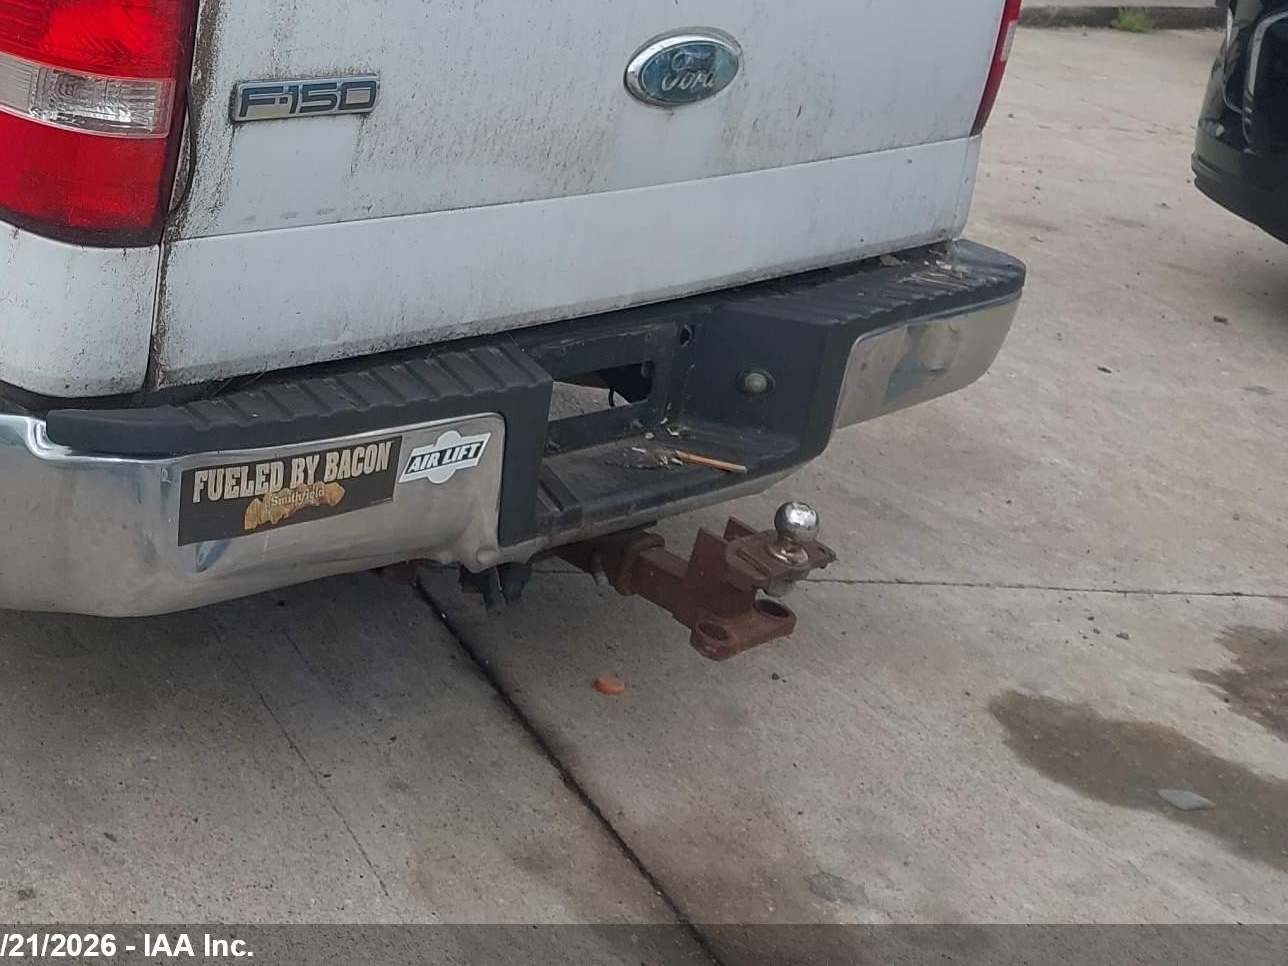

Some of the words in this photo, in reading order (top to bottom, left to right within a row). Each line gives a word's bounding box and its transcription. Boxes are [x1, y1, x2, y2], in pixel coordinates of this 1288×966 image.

[661, 49, 716, 91] Ford
[239, 80, 377, 118] F-150
[192, 460, 285, 504] FUELED
[290, 452, 320, 489] BY
[323, 441, 393, 483] BACON
[407, 452, 441, 473] AIR
[441, 442, 481, 465] LIFT
